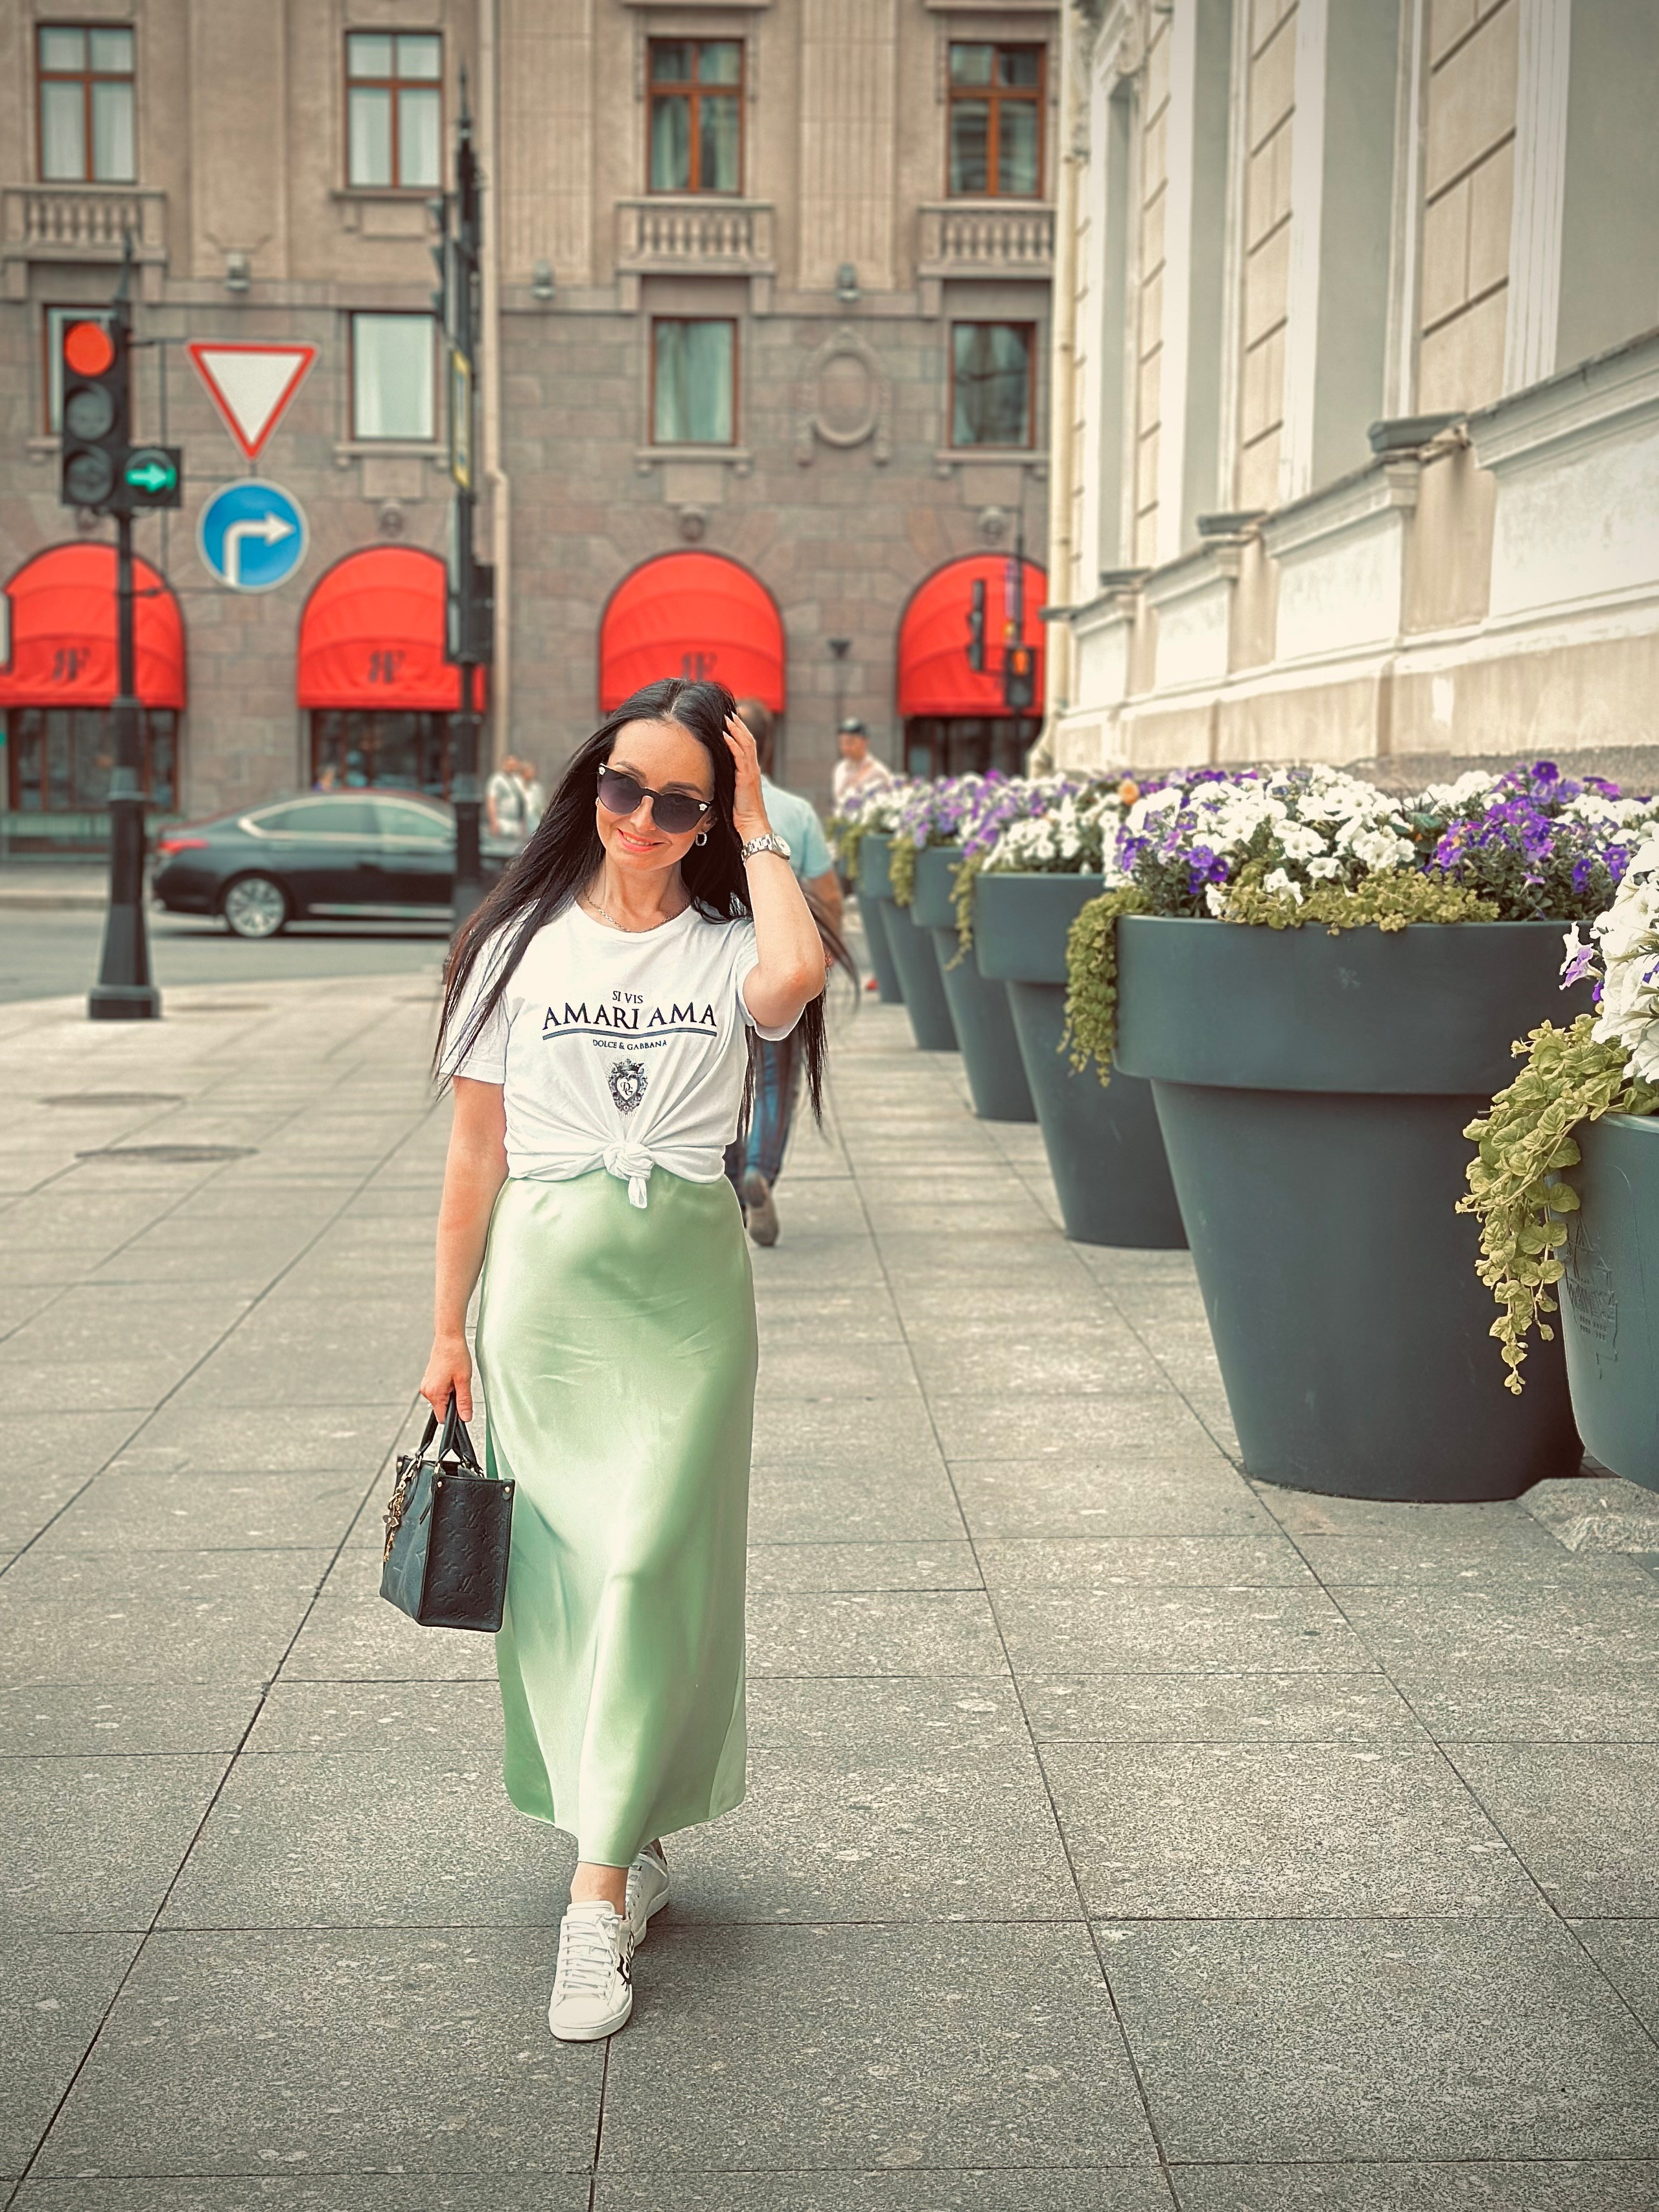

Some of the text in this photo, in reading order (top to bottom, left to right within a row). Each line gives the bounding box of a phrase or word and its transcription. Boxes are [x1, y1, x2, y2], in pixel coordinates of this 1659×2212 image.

[612, 990, 644, 1004] SI VIS
[542, 1001, 717, 1030] AMARI AMA
[592, 1039, 667, 1051] DOLCE & GABBANA
